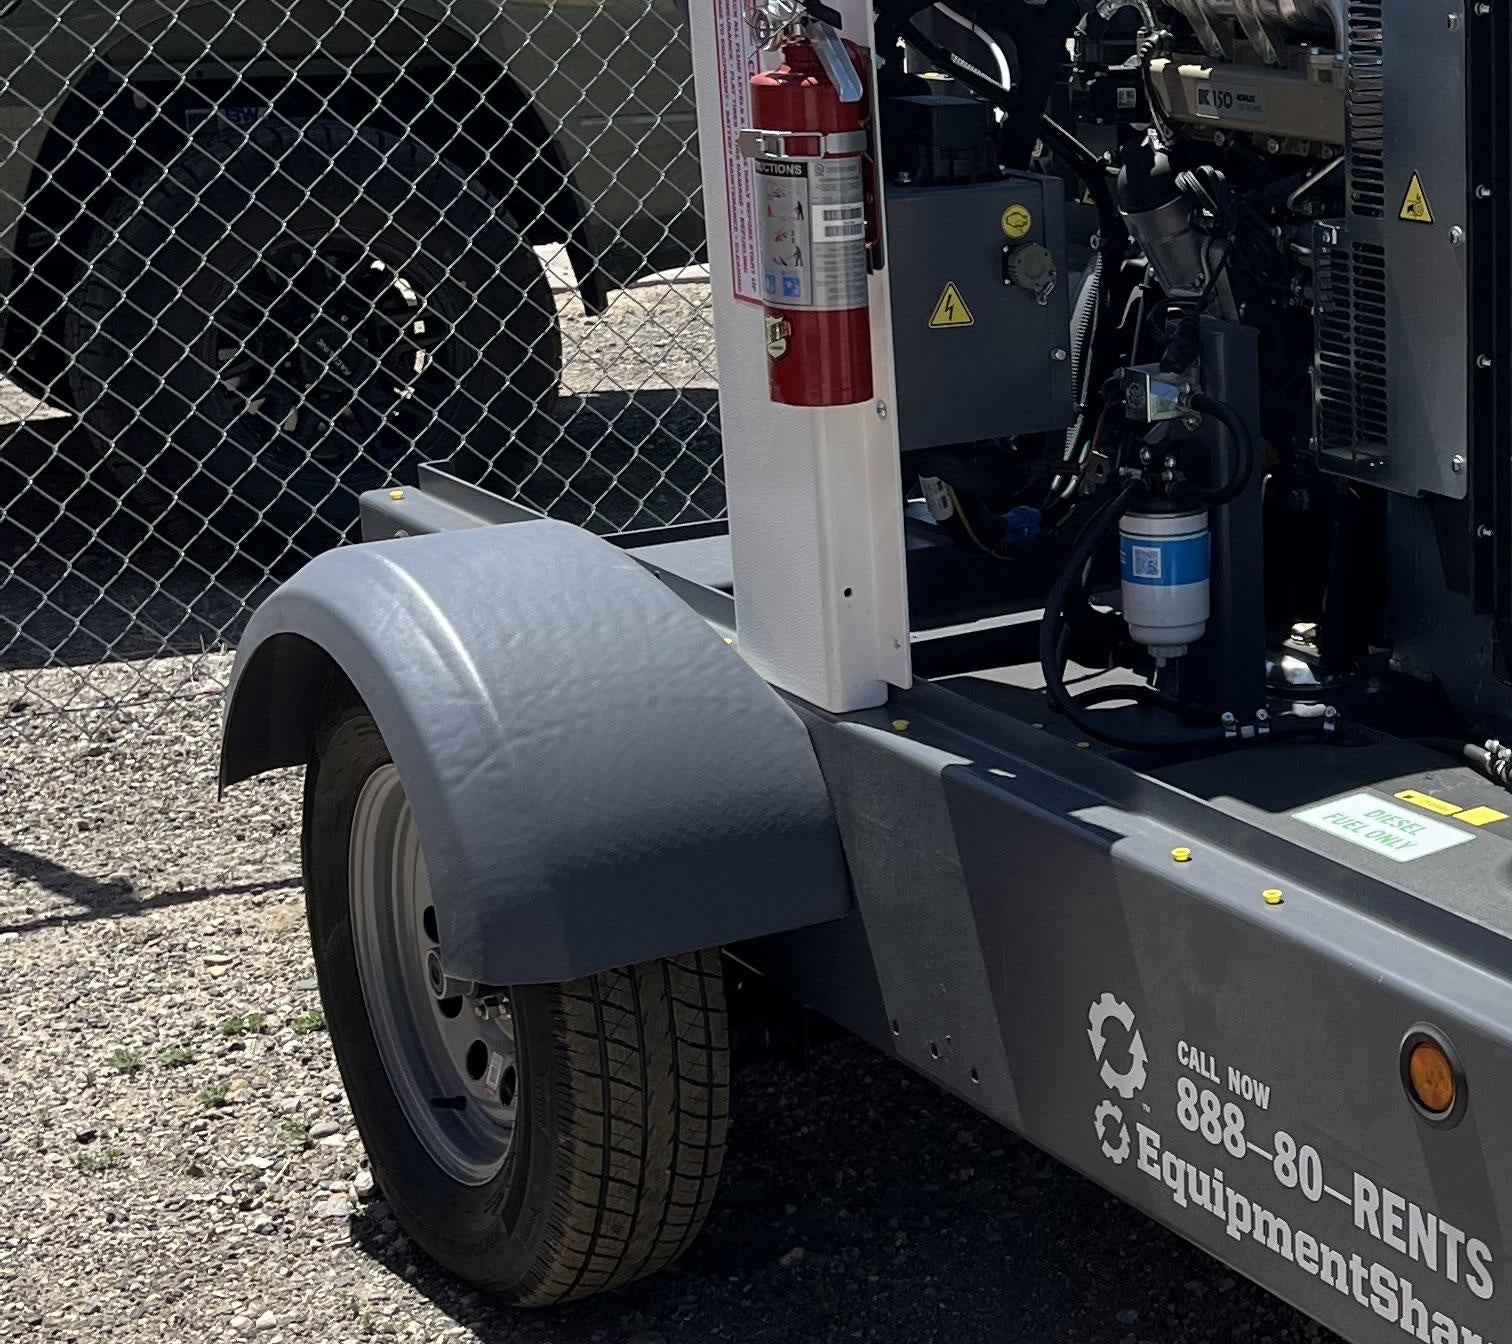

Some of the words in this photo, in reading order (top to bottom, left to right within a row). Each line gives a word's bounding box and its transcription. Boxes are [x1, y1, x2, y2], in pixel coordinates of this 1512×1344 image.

[718, 22, 724, 36] TO
[719, 37, 729, 99] EQUIPMENT
[724, 0, 733, 60] INSURANCE
[735, 163, 743, 208] DAMAGE
[725, 109, 733, 155] BATTERY
[728, 157, 738, 233] MAINTENANCE
[745, 201, 753, 241] BEFORE
[1322, 812, 1369, 835] FUEL
[1366, 828, 1418, 850] ONLY
[1363, 808, 1427, 837] DIESEL
[1176, 1039, 1221, 1085] CALL
[1227, 1065, 1271, 1110] NOW
